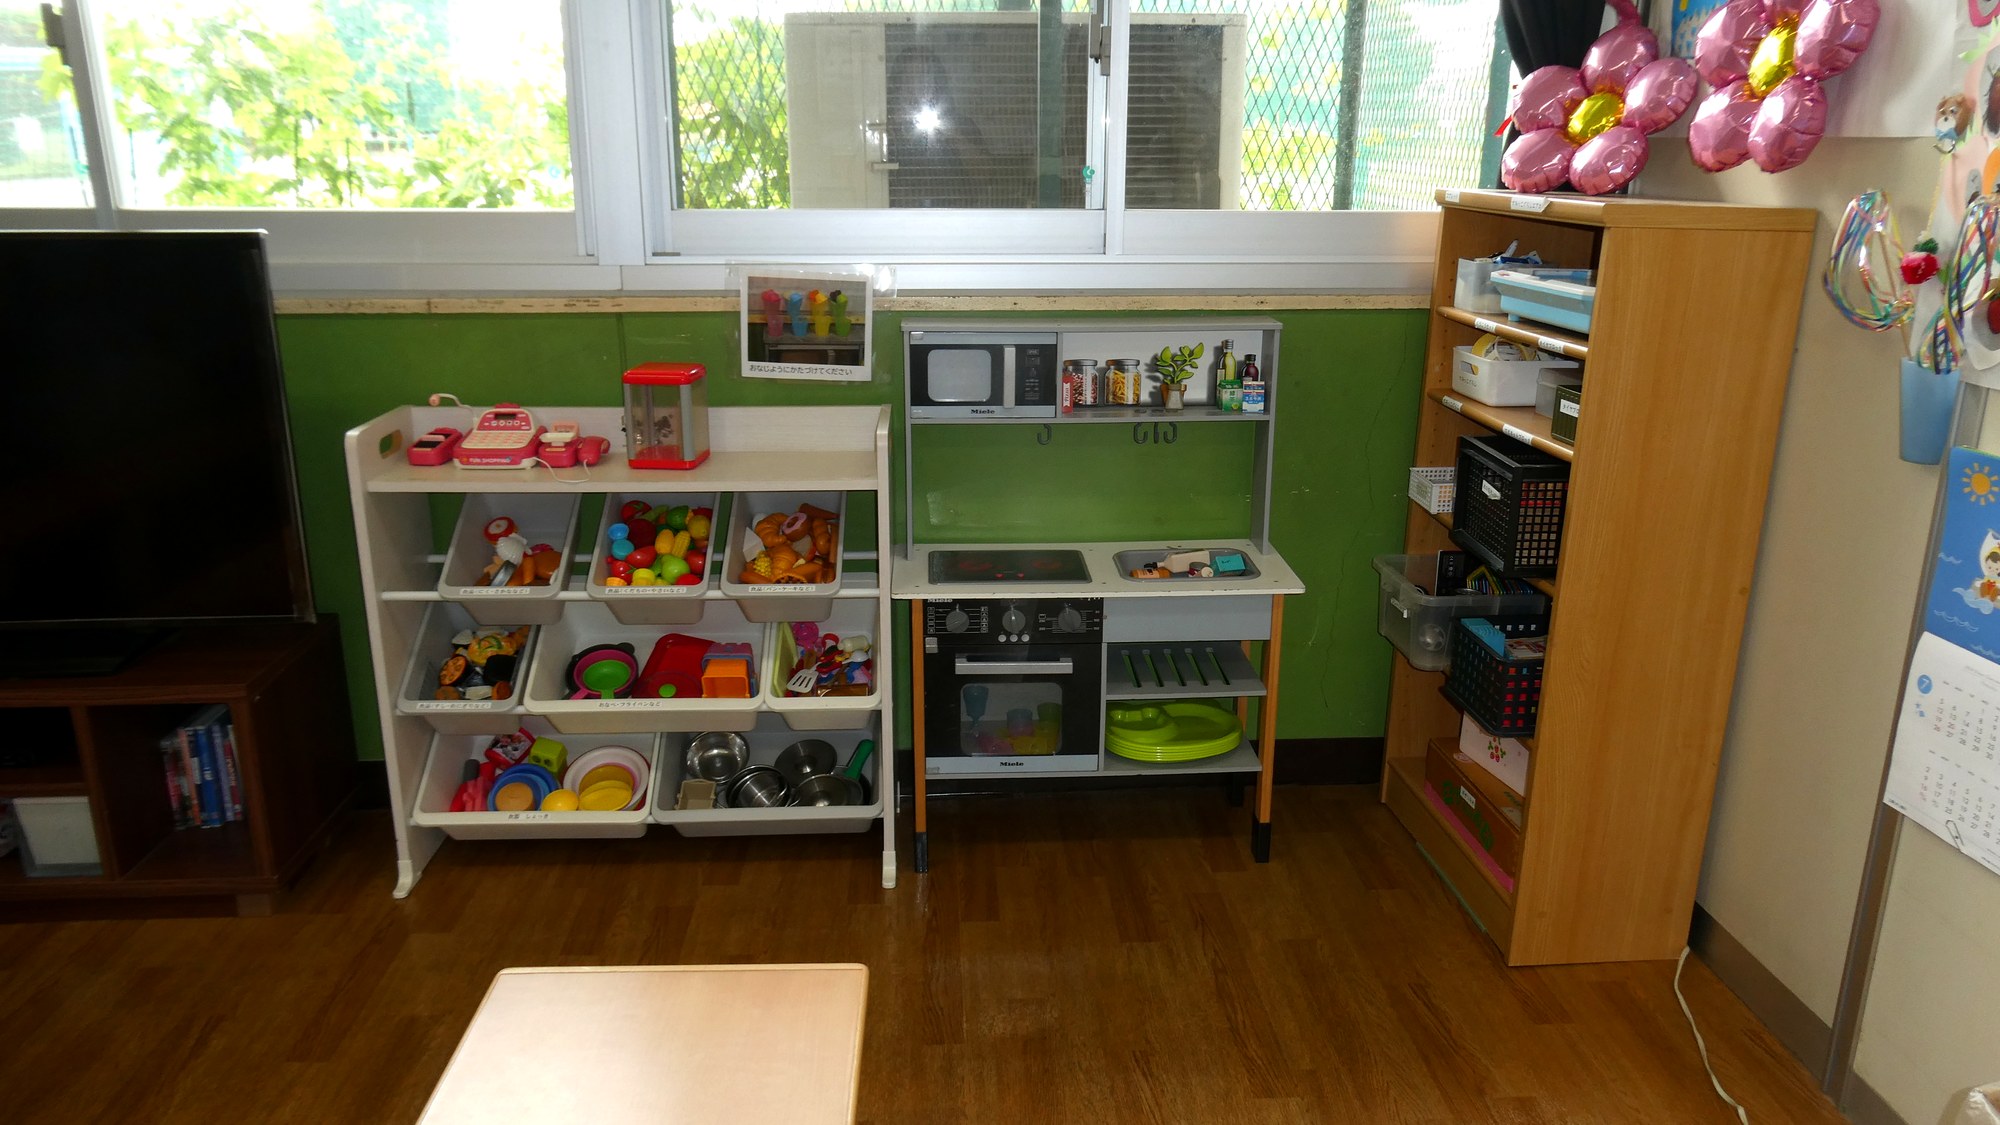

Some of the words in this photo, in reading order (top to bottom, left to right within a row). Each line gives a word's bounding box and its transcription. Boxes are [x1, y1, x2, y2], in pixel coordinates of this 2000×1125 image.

[749, 364, 853, 376] おなじようにかたづけてください
